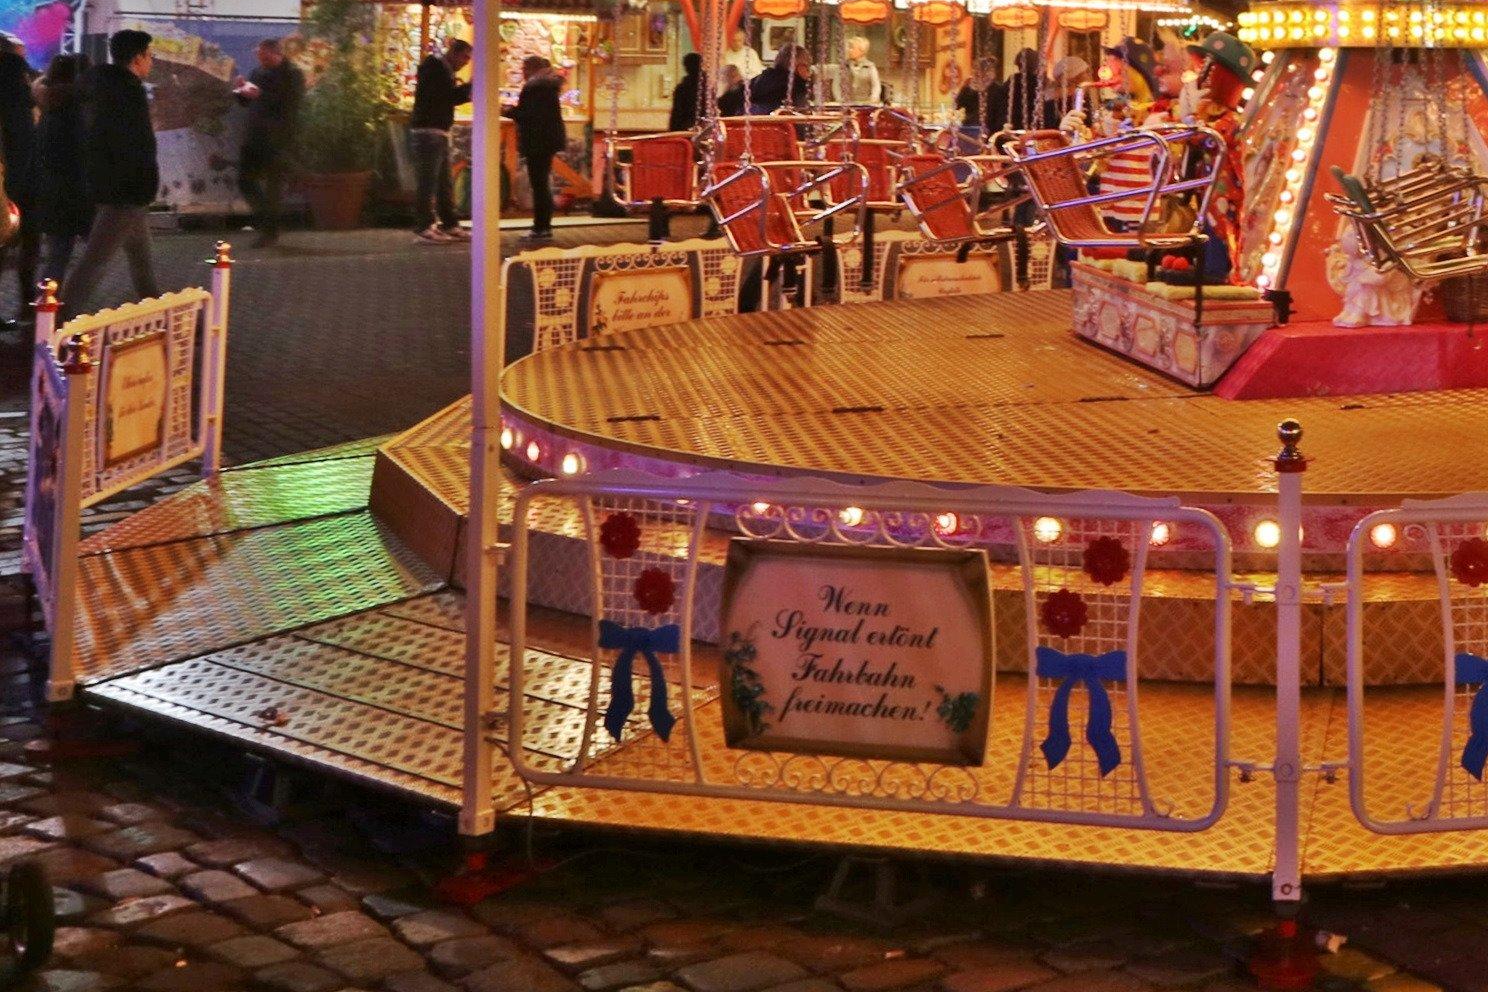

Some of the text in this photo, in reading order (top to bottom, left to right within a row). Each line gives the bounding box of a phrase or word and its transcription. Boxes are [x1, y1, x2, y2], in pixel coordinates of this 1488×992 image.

[818, 584, 891, 616] Wenn
[770, 610, 938, 651] Signal ertönt
[791, 653, 916, 689] Fahrbahn
[778, 687, 932, 722] freimachen!
